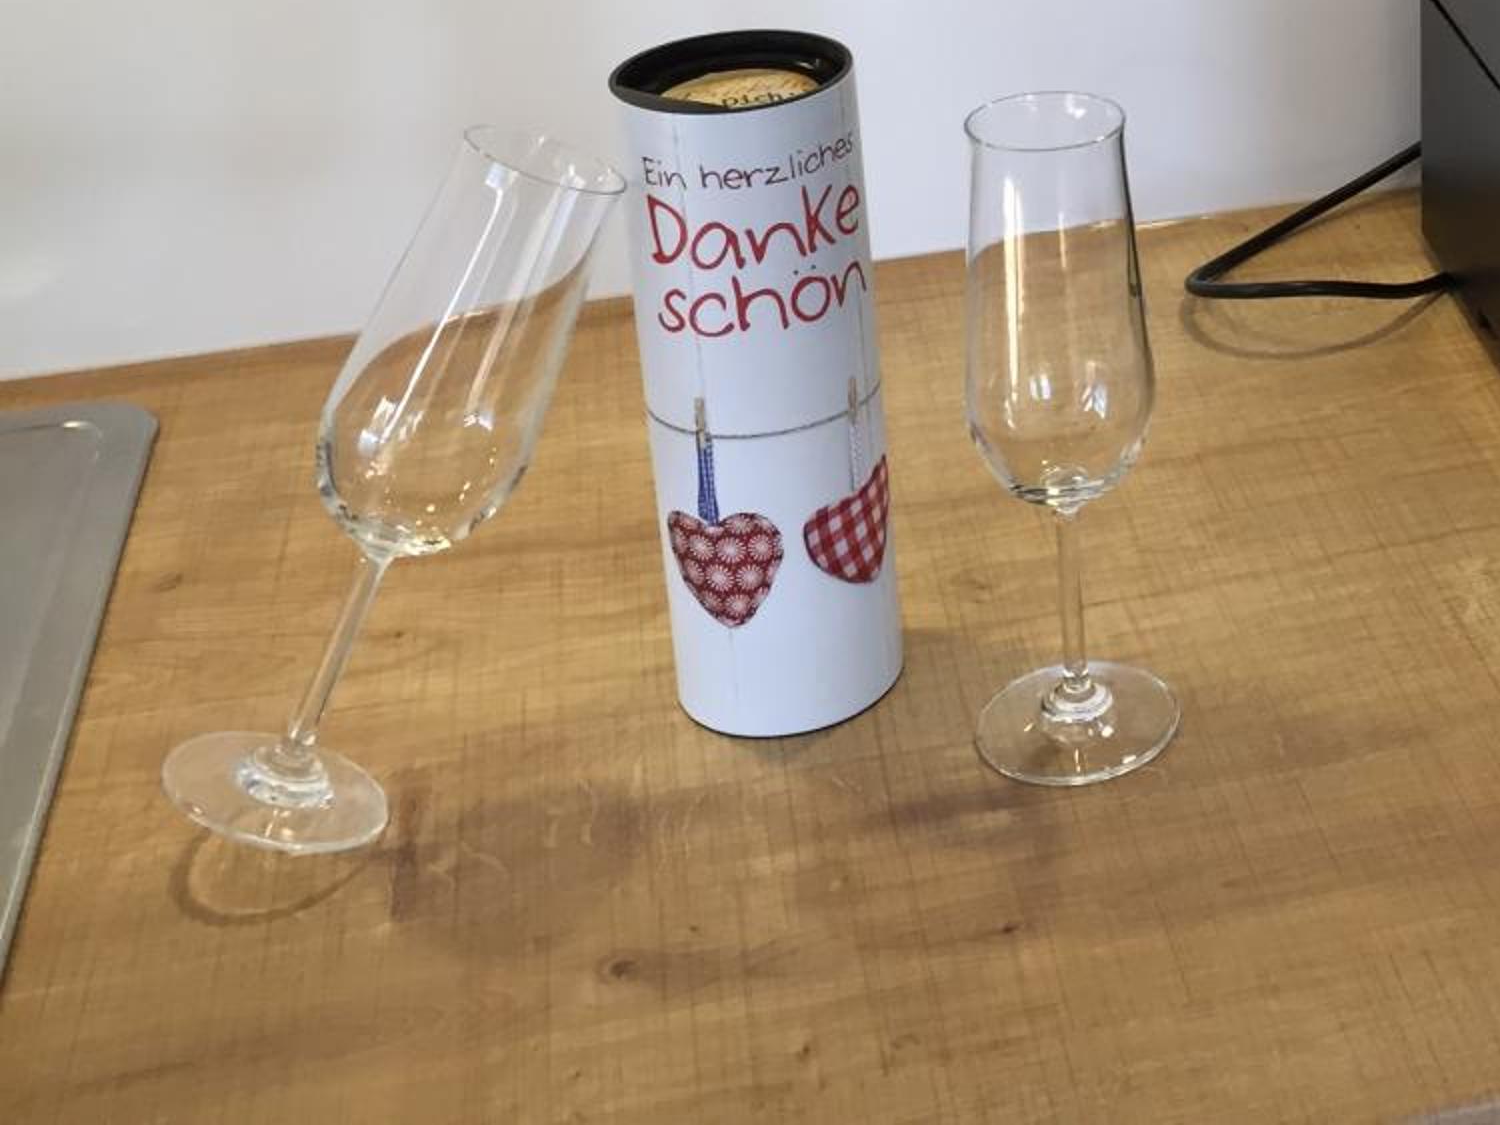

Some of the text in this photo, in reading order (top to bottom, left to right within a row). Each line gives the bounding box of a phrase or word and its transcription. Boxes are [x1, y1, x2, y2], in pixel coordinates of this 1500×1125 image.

[641, 156, 687, 190] Ein
[647, 184, 859, 270] Danke
[658, 261, 867, 338] schön
